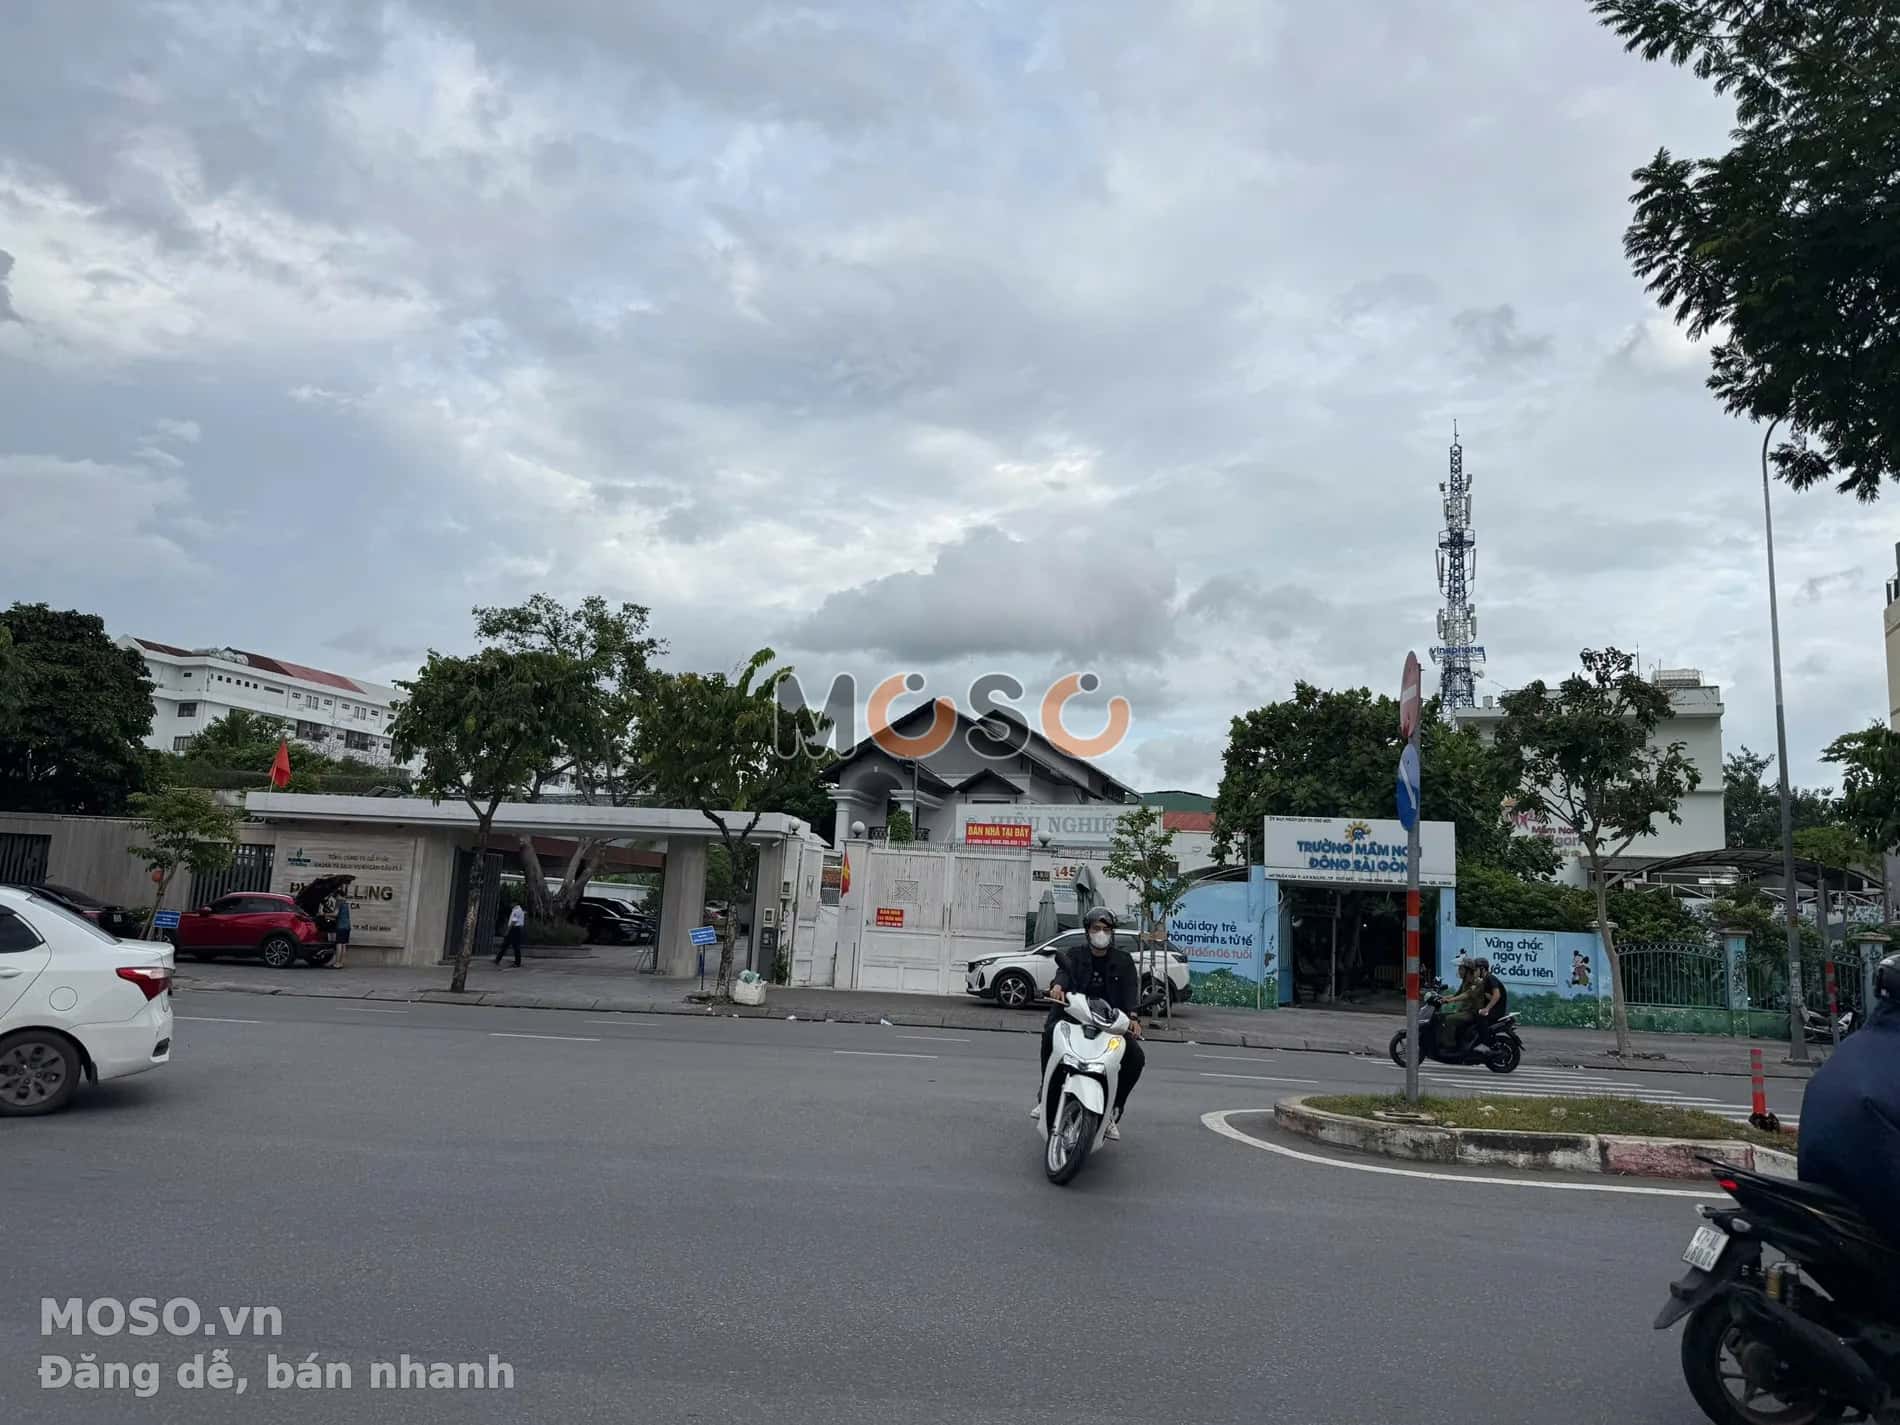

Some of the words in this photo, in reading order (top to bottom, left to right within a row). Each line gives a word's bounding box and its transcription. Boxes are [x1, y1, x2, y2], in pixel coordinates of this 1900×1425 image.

[968, 825, 983, 836] BÁN
[985, 826, 1000, 836] NHÀ
[1002, 827, 1013, 838] TẠI
[1015, 826, 1030, 838] ĐÂY
[1048, 812, 1116, 837] NGHIỆ
[1297, 838, 1352, 853] TRƯỜNG
[1355, 841, 1389, 856] MẦM
[1391, 845, 1408, 857] NO
[1309, 855, 1350, 870] ĐÔNG
[1353, 856, 1375, 872] SÀI
[1173, 919, 1197, 930] Nuôi
[1198, 920, 1218, 933] dạy
[1222, 921, 1237, 932] trẻ
[1242, 933, 1253, 946] tế
[1484, 937, 1514, 951] Vững
[1517, 937, 1544, 950] chắc
[1493, 951, 1522, 963] ngay
[1525, 951, 1538, 962] từ
[1508, 964, 1530, 977] đầu
[1533, 967, 1554, 977] tiên
